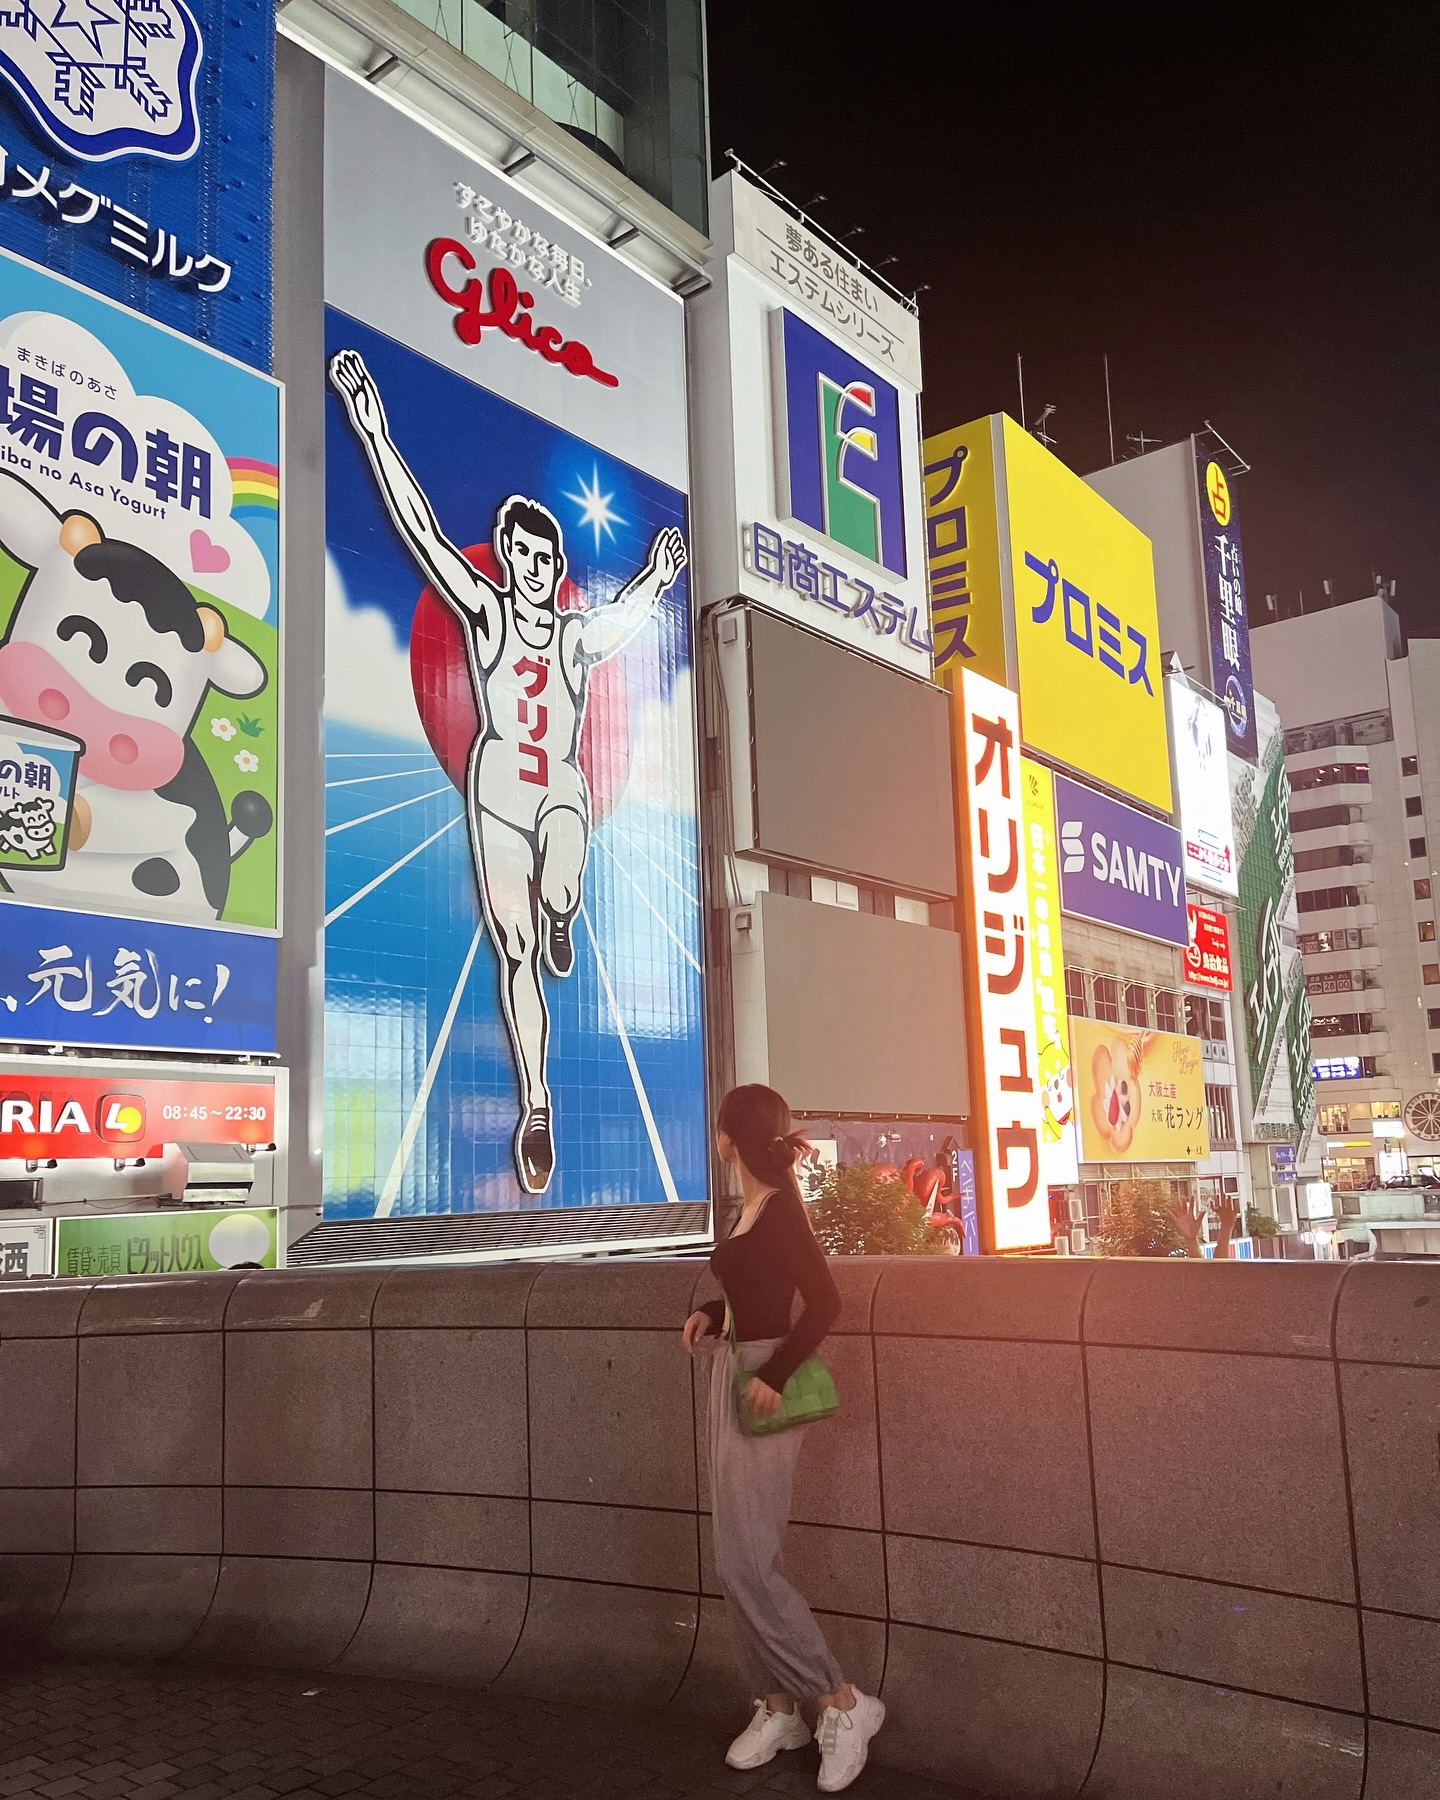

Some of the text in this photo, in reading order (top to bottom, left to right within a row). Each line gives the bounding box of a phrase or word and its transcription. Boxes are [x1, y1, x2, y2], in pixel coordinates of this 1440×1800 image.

[425, 237, 619, 388] Glico
[465, 217, 581, 307] ゆたかな人生
[770, 250, 895, 362] エステムシリーズ
[786, 223, 878, 312] 夢ある住まい
[17, 346, 117, 400] まきばのあさ
[1, 445, 166, 519] iba no Asa Yogurt
[754, 522, 934, 653] 日商エステム
[924, 446, 977, 668] プロミス
[1215, 535, 1240, 671] 千里眼
[1025, 551, 1154, 697] プロミス
[512, 655, 551, 788] グリコ
[1091, 832, 1181, 907] SAMTY
[972, 713, 1039, 1208] オリジュウ
[1148, 1081, 1177, 1099] 大阪土産
[66, 1234, 205, 1276] 賃貸・売買 ピタットハウス
